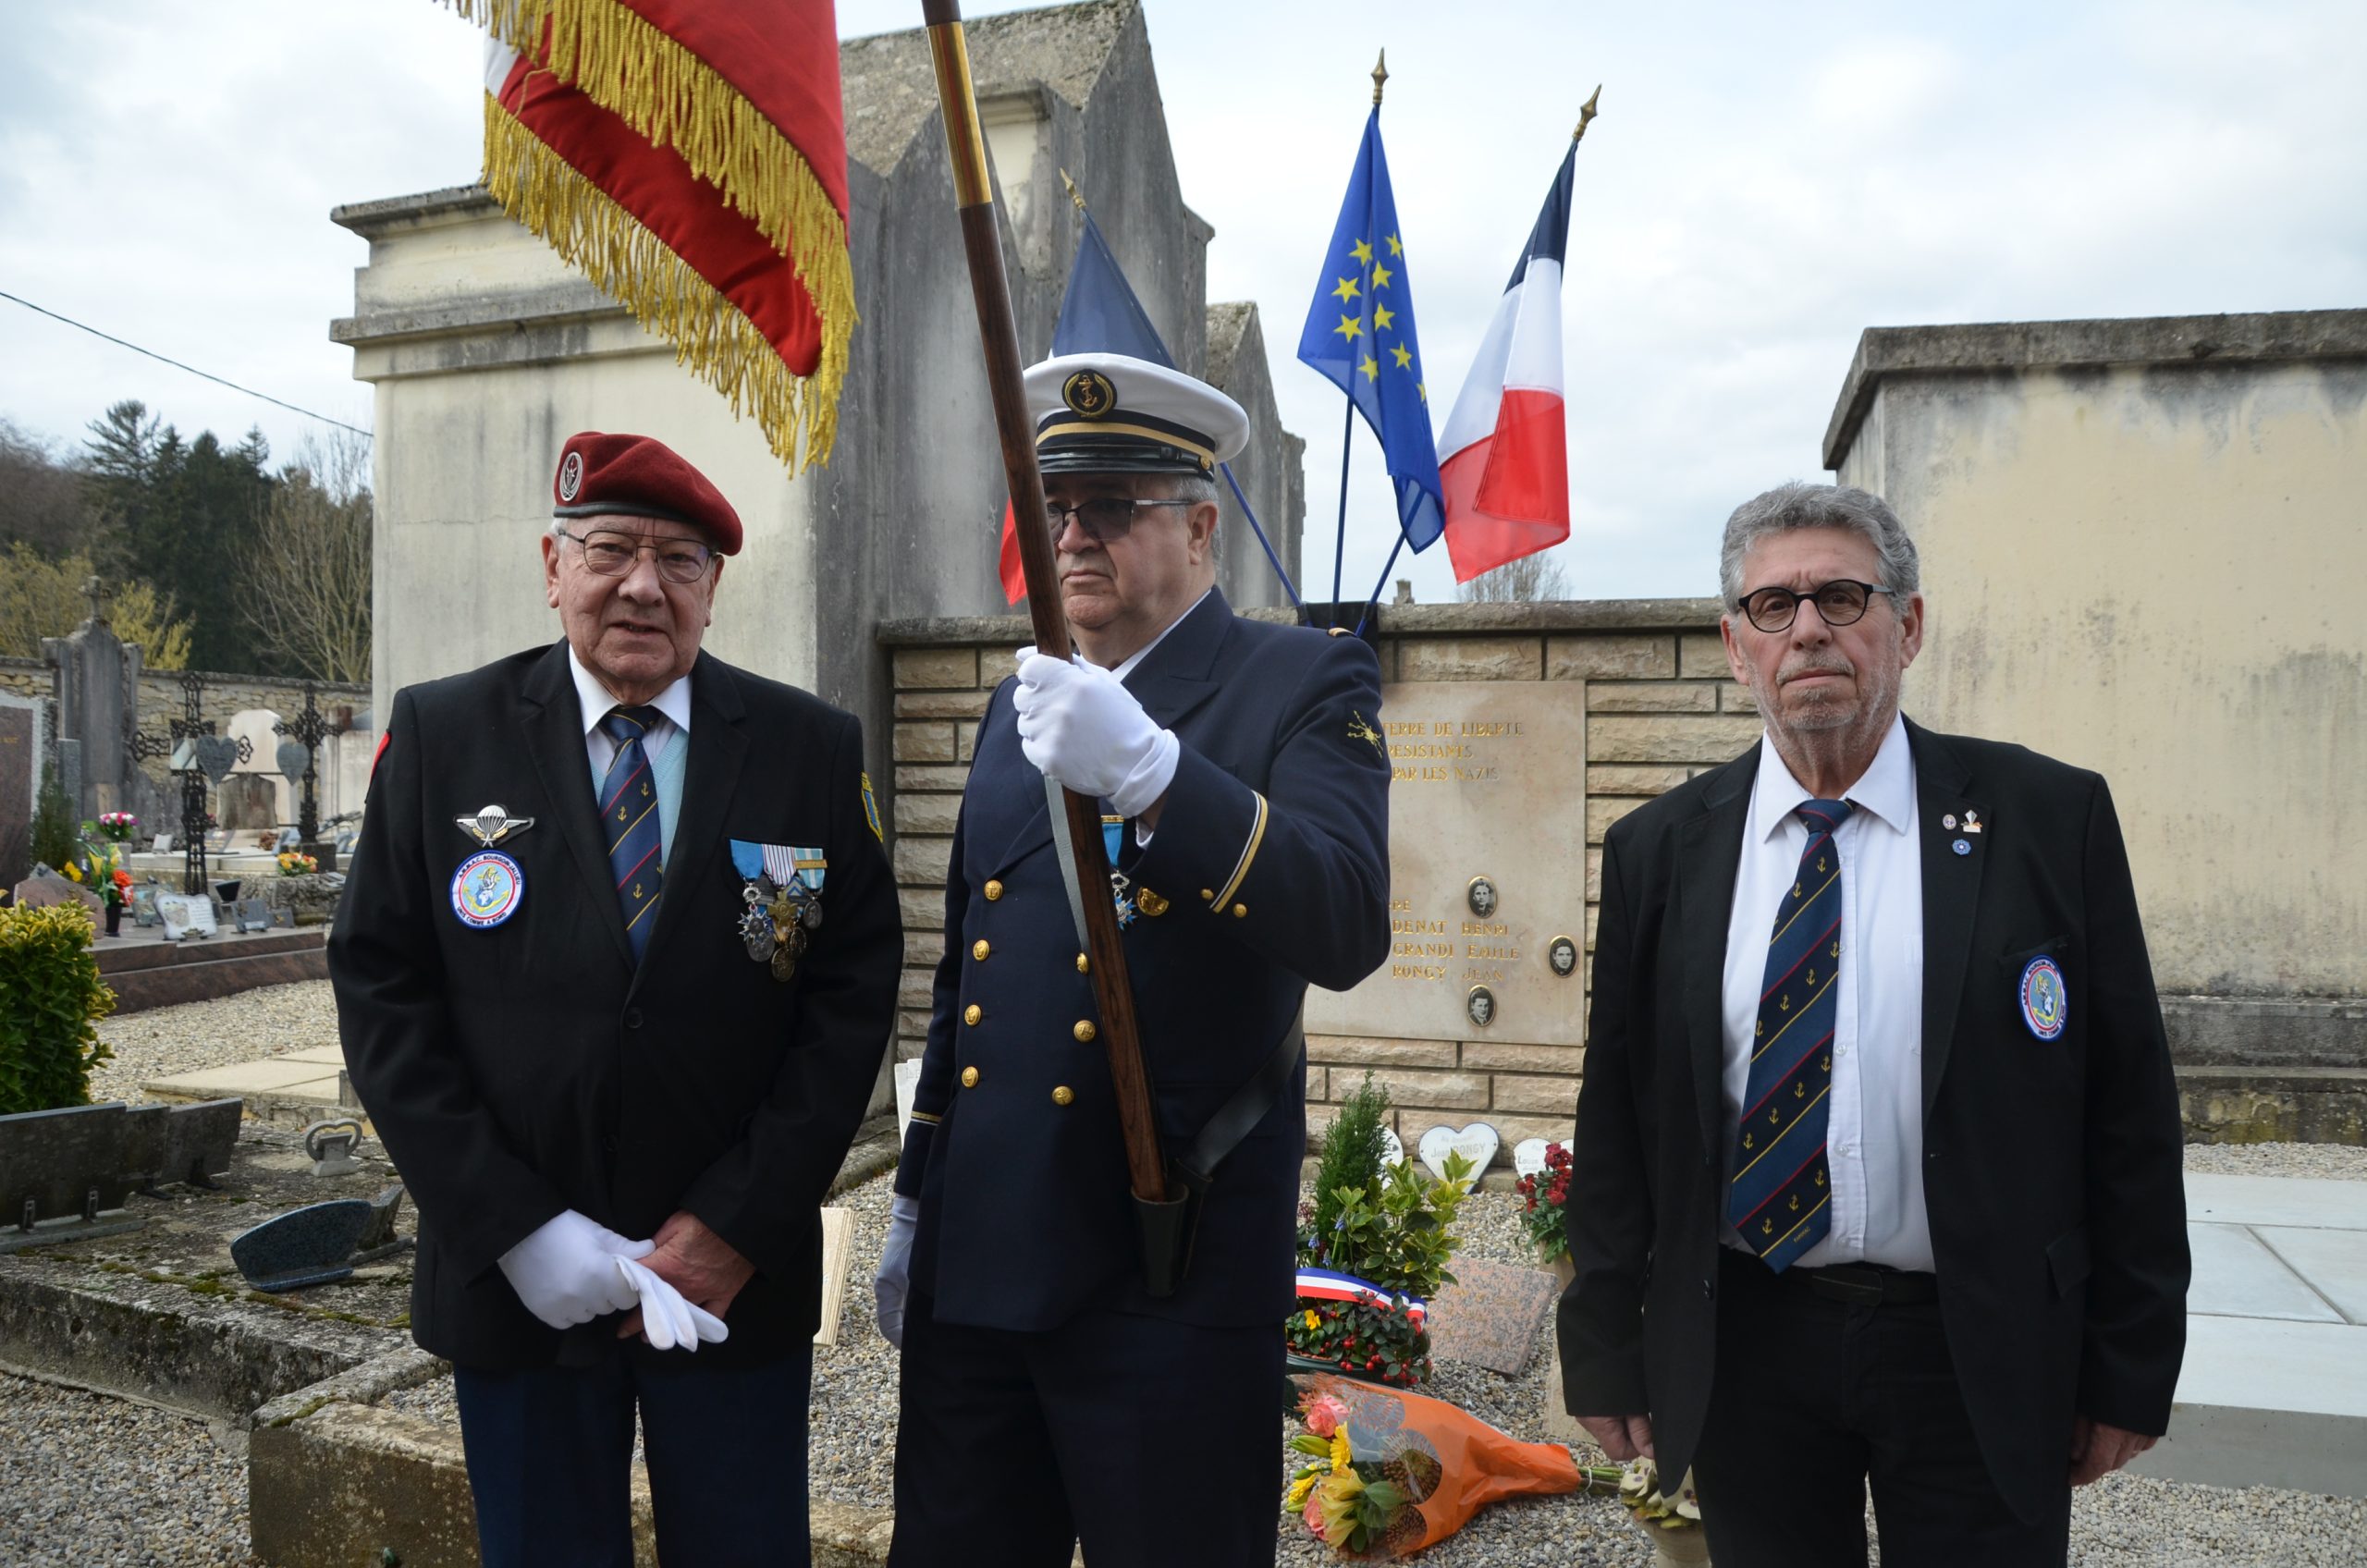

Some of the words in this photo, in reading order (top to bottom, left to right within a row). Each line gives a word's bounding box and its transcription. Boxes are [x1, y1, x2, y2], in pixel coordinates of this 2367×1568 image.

[1434, 722, 1453, 737] DE
[1462, 722, 1524, 737] LIBERTE
[1392, 766, 1417, 782] PAR
[1423, 766, 1449, 781] LES
[1454, 766, 1501, 781] NAZIS
[1392, 919, 1448, 935] DENAT
[1462, 921, 1509, 937] HENRI
[1392, 942, 1454, 958] GRANDI
[1467, 944, 1519, 961] EMILE
[1392, 964, 1447, 980] RONGY
[1462, 967, 1504, 982] JEAN
